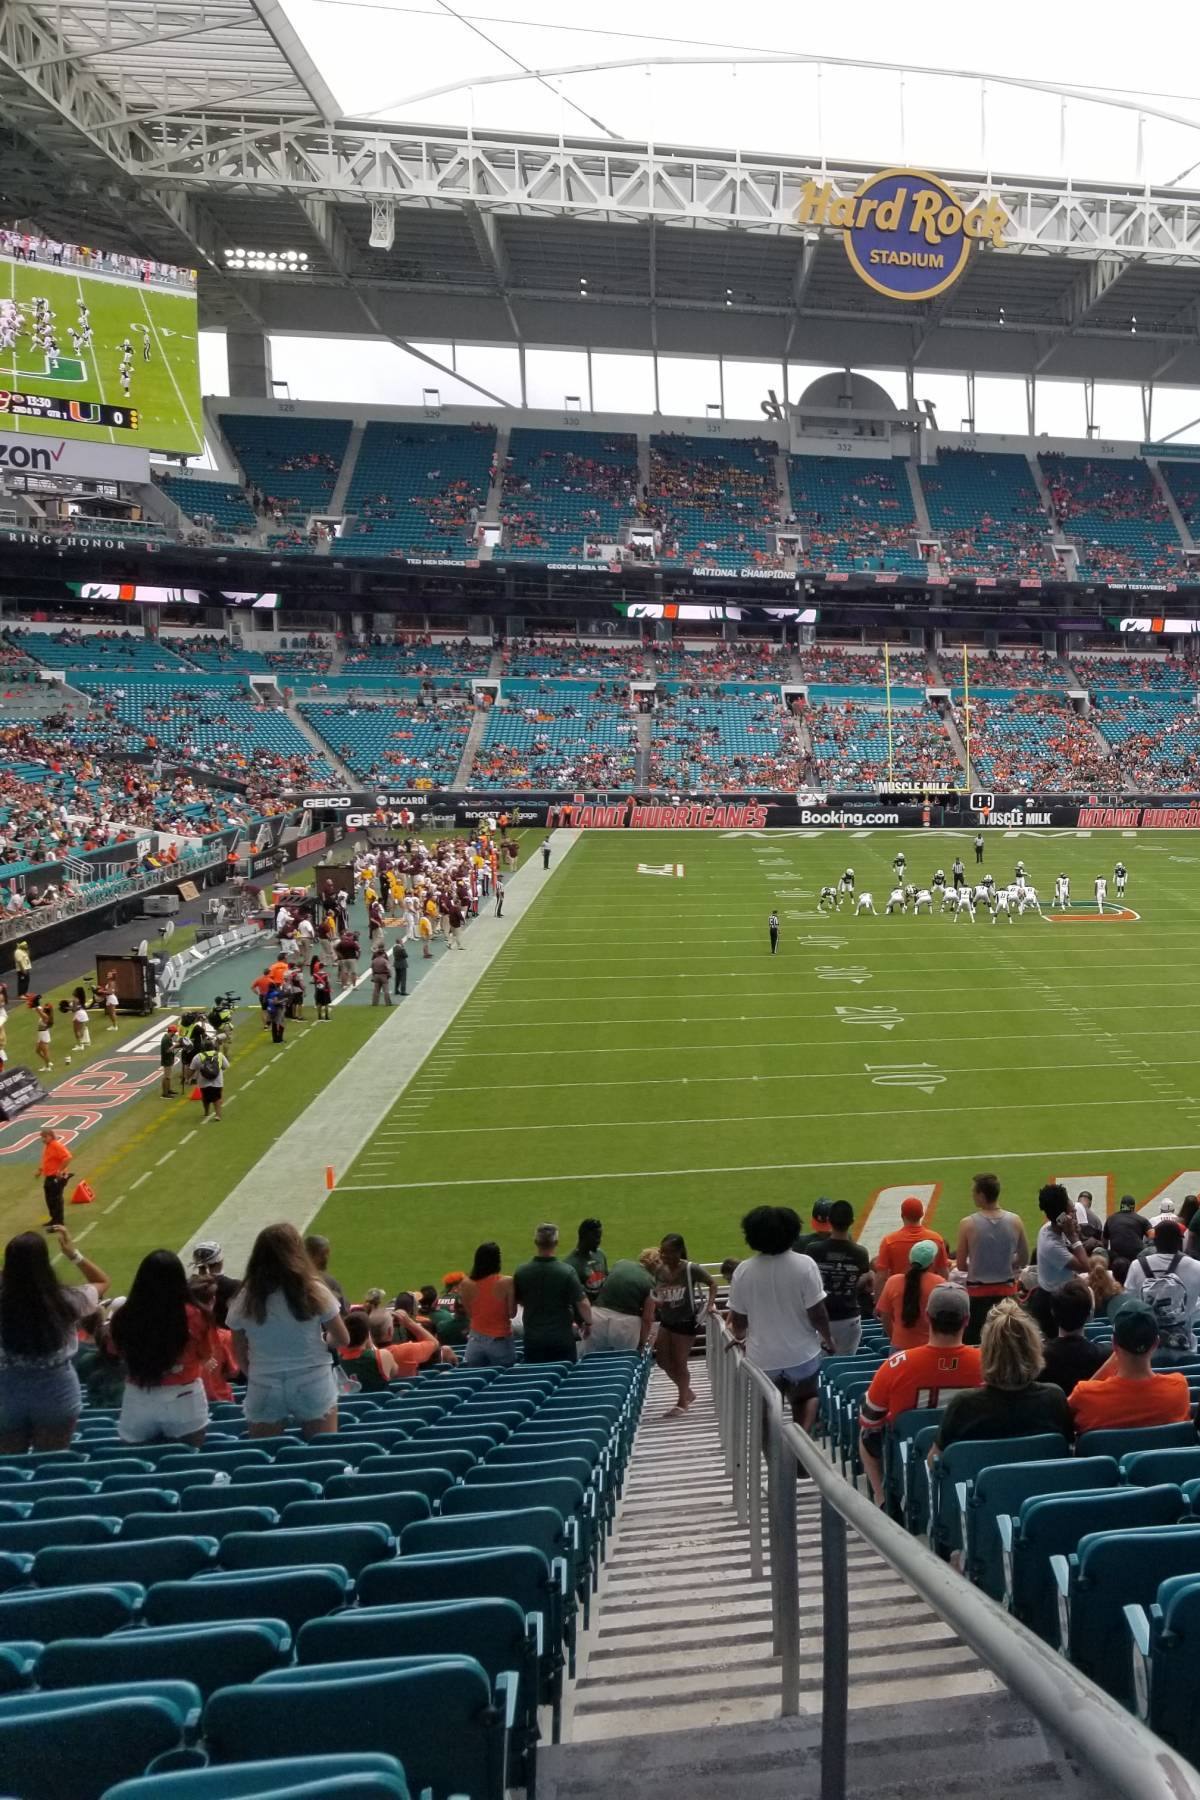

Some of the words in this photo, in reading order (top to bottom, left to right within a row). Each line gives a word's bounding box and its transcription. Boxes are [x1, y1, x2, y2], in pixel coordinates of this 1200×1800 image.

[799, 181, 906, 232] Hard
[909, 189, 1008, 248] Rock
[870, 249, 944, 268] STADIUM
[113, 411, 124, 425] 0
[10, 532, 51, 545] RING
[67, 537, 126, 550] HONOR
[692, 568, 737, 578] NATIONAL
[741, 569, 796, 580] CHAMPIONS
[879, 782, 919, 794] MUSCLE
[923, 783, 950, 795] MILK
[303, 797, 351, 808] GEICO
[390, 795, 427, 805] BACARDÍ
[630, 806, 768, 828] HURRICANES
[801, 811, 899, 828] Booking.com
[1026, 812, 1051, 825] MILK
[1077, 809, 1140, 828] MIAMI
[814, 965, 873, 980] 30
[834, 1005, 905, 1024] 20
[863, 1062, 948, 1086] 10
